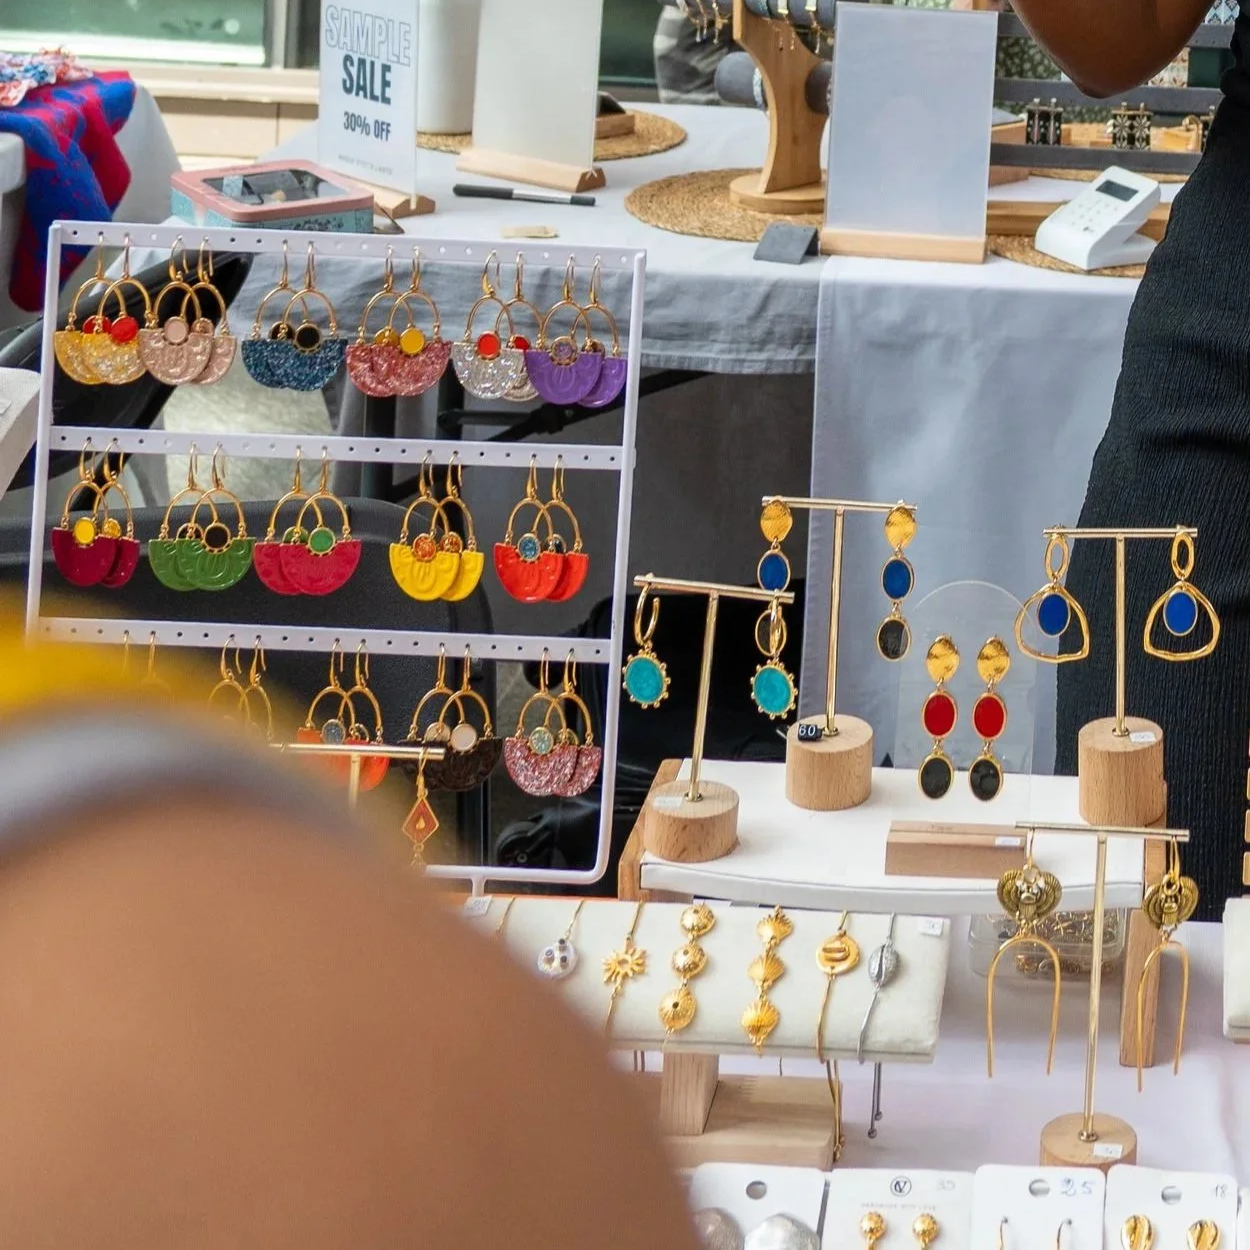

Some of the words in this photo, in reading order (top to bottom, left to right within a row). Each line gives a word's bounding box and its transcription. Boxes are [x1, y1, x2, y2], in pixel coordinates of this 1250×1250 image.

[325, 5, 411, 67] SAMPLE
[342, 54, 391, 105] SALE
[343, 111, 370, 137] 30%
[373, 119, 391, 142] OFF
[799, 725, 816, 737] 60
